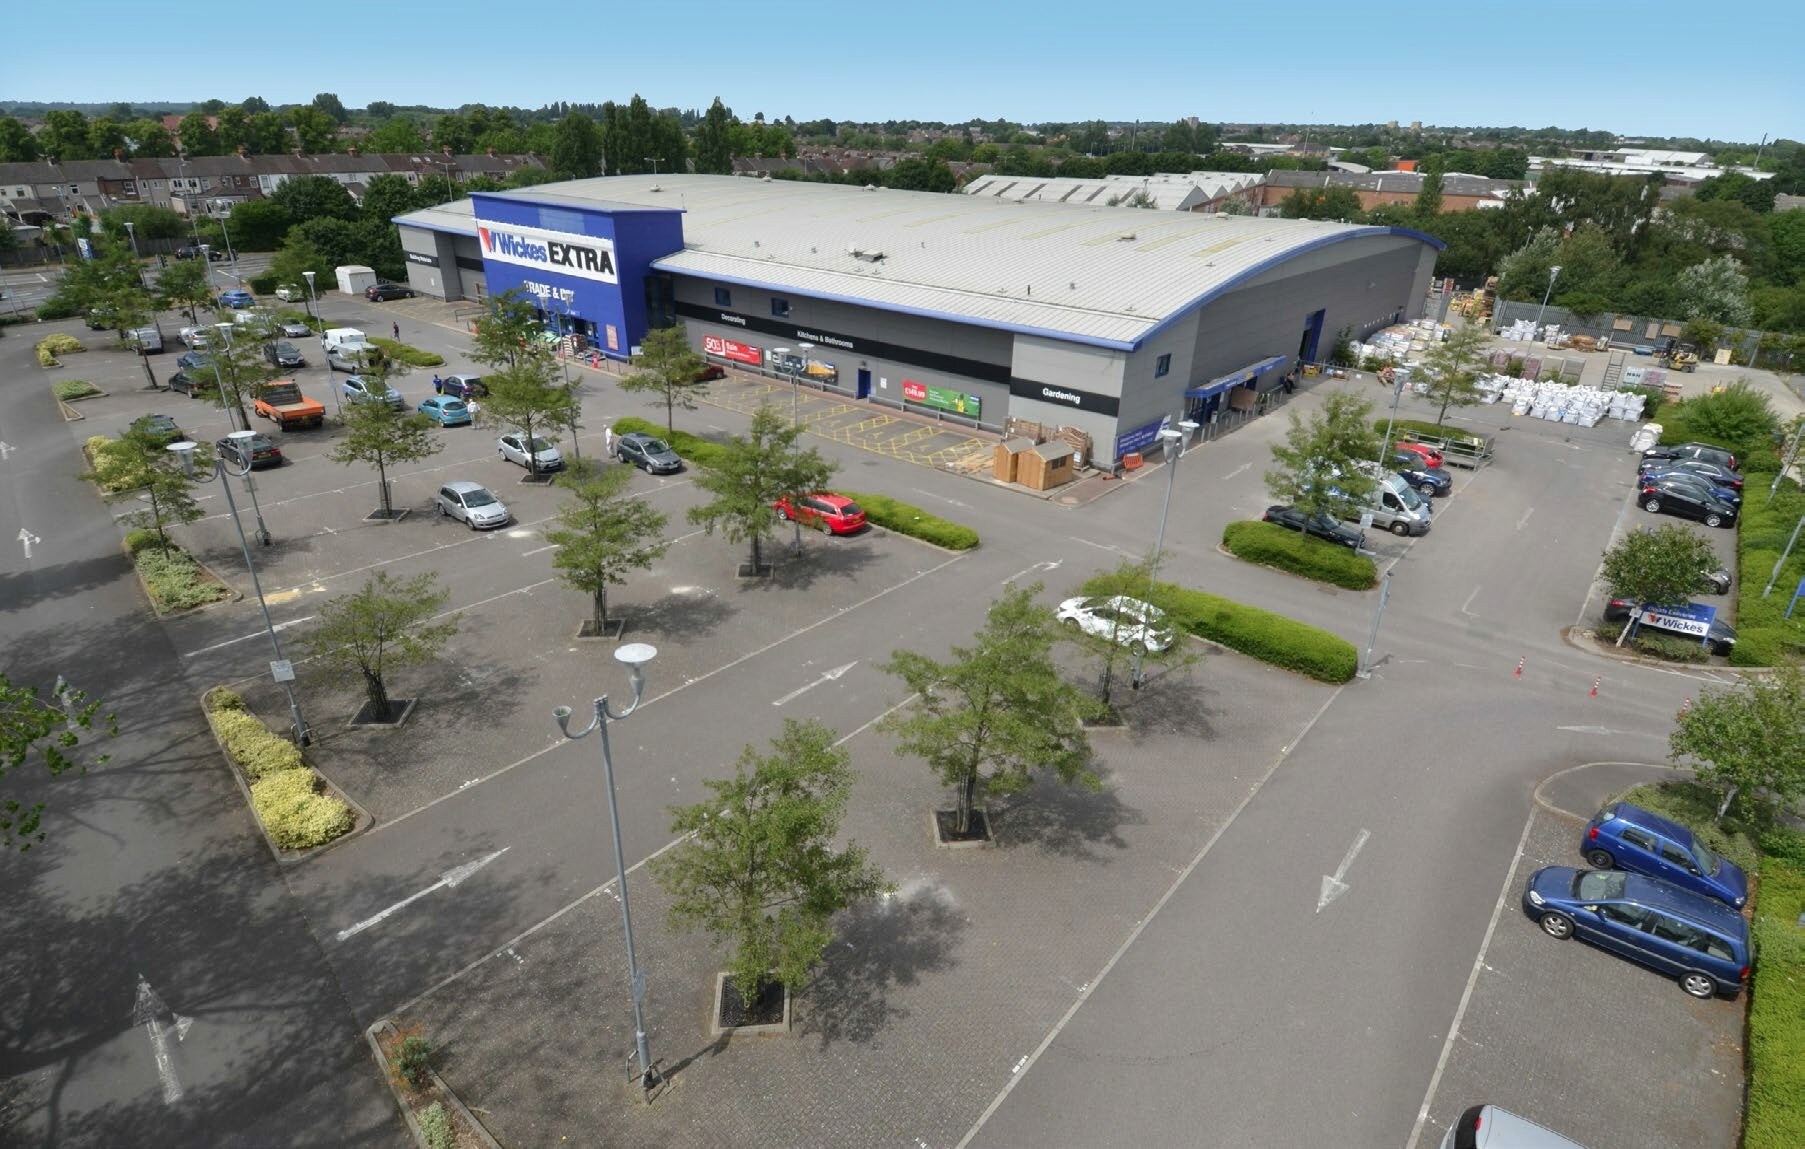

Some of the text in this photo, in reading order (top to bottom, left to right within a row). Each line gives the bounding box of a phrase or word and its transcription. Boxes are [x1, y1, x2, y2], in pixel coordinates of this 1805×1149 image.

[498, 233, 615, 275] Wickes EXTRA
[552, 287, 560, 299] &
[1042, 387, 1080, 405] Gardening
[1663, 618, 1704, 633] Wickes
